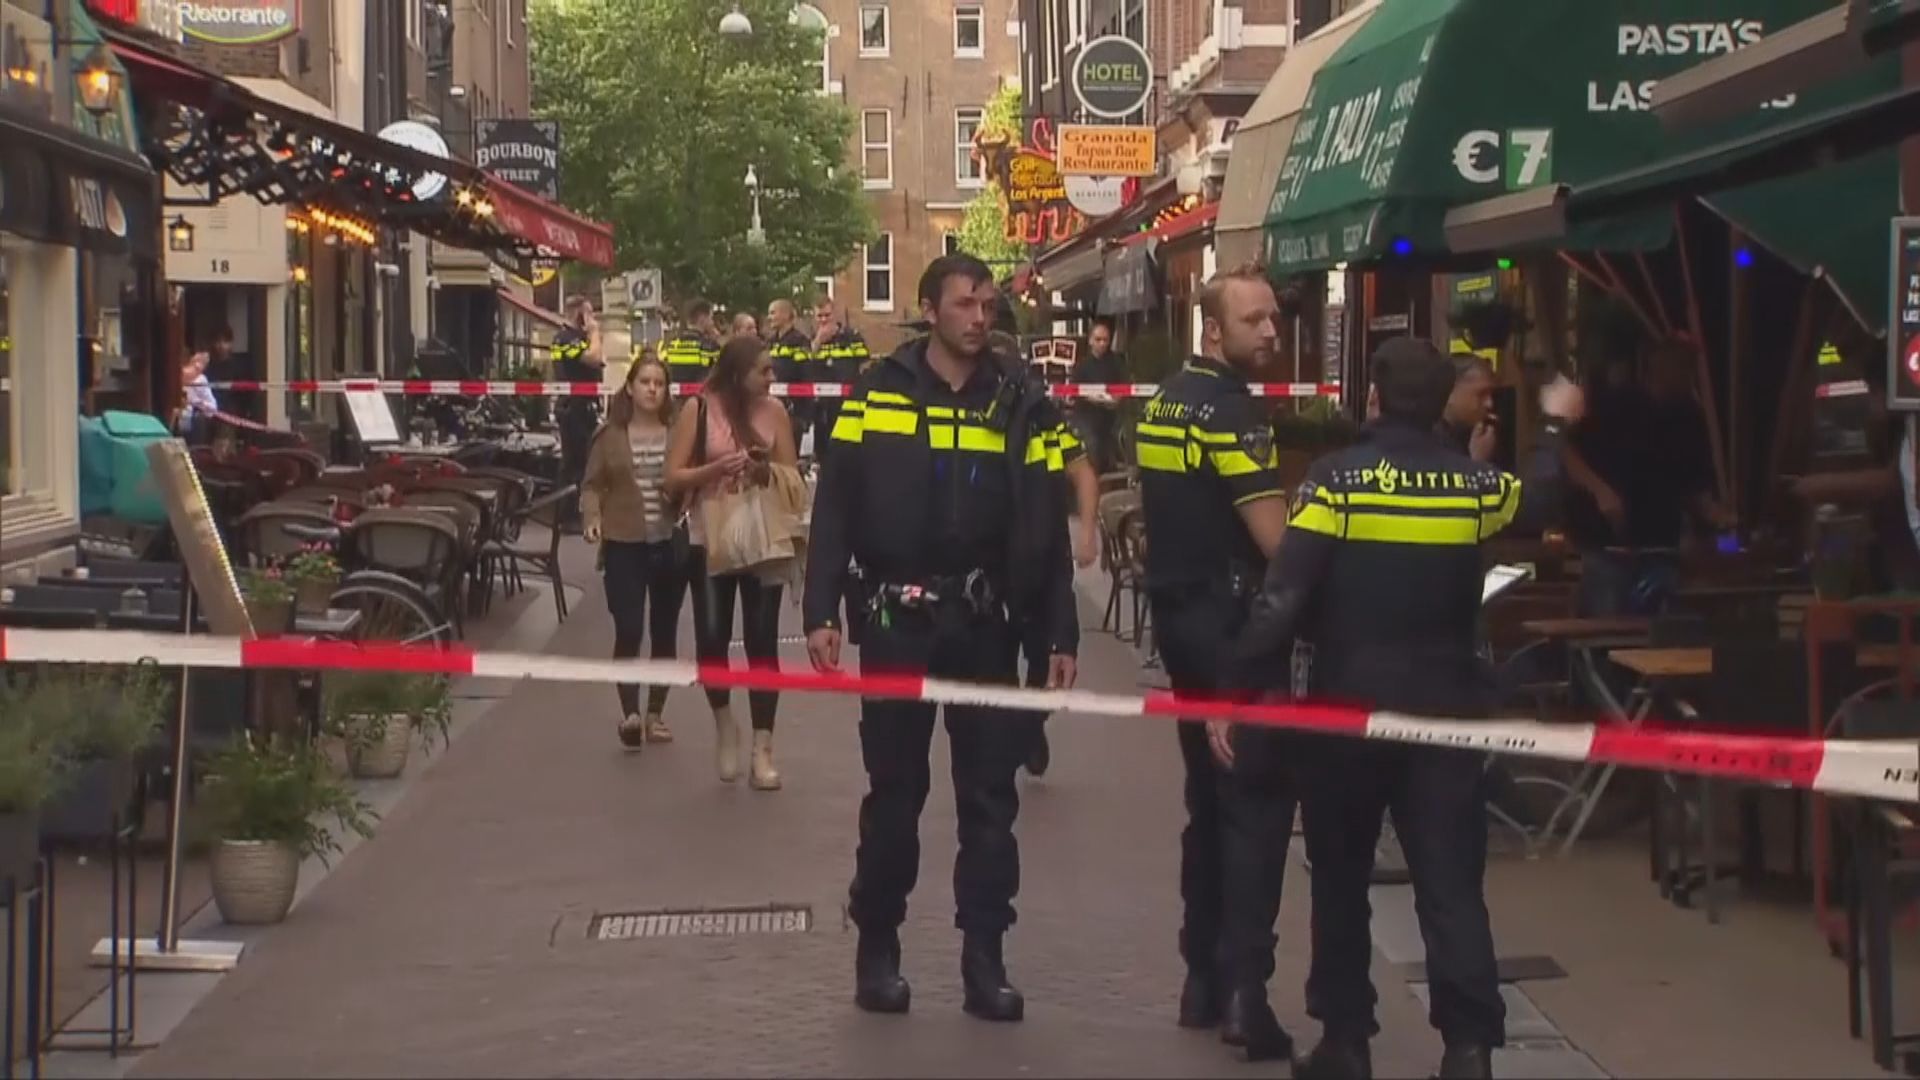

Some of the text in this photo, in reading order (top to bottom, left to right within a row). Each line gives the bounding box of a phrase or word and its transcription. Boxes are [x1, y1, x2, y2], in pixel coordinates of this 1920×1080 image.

[180, 2, 287, 25] Ristorante
[1083, 63, 1143, 81] HOTEL
[1064, 131, 1148, 143] Granada
[476, 142, 557, 170] BOURBON
[1063, 157, 1149, 169] Restaurante
[211, 259, 230, 273] 18
